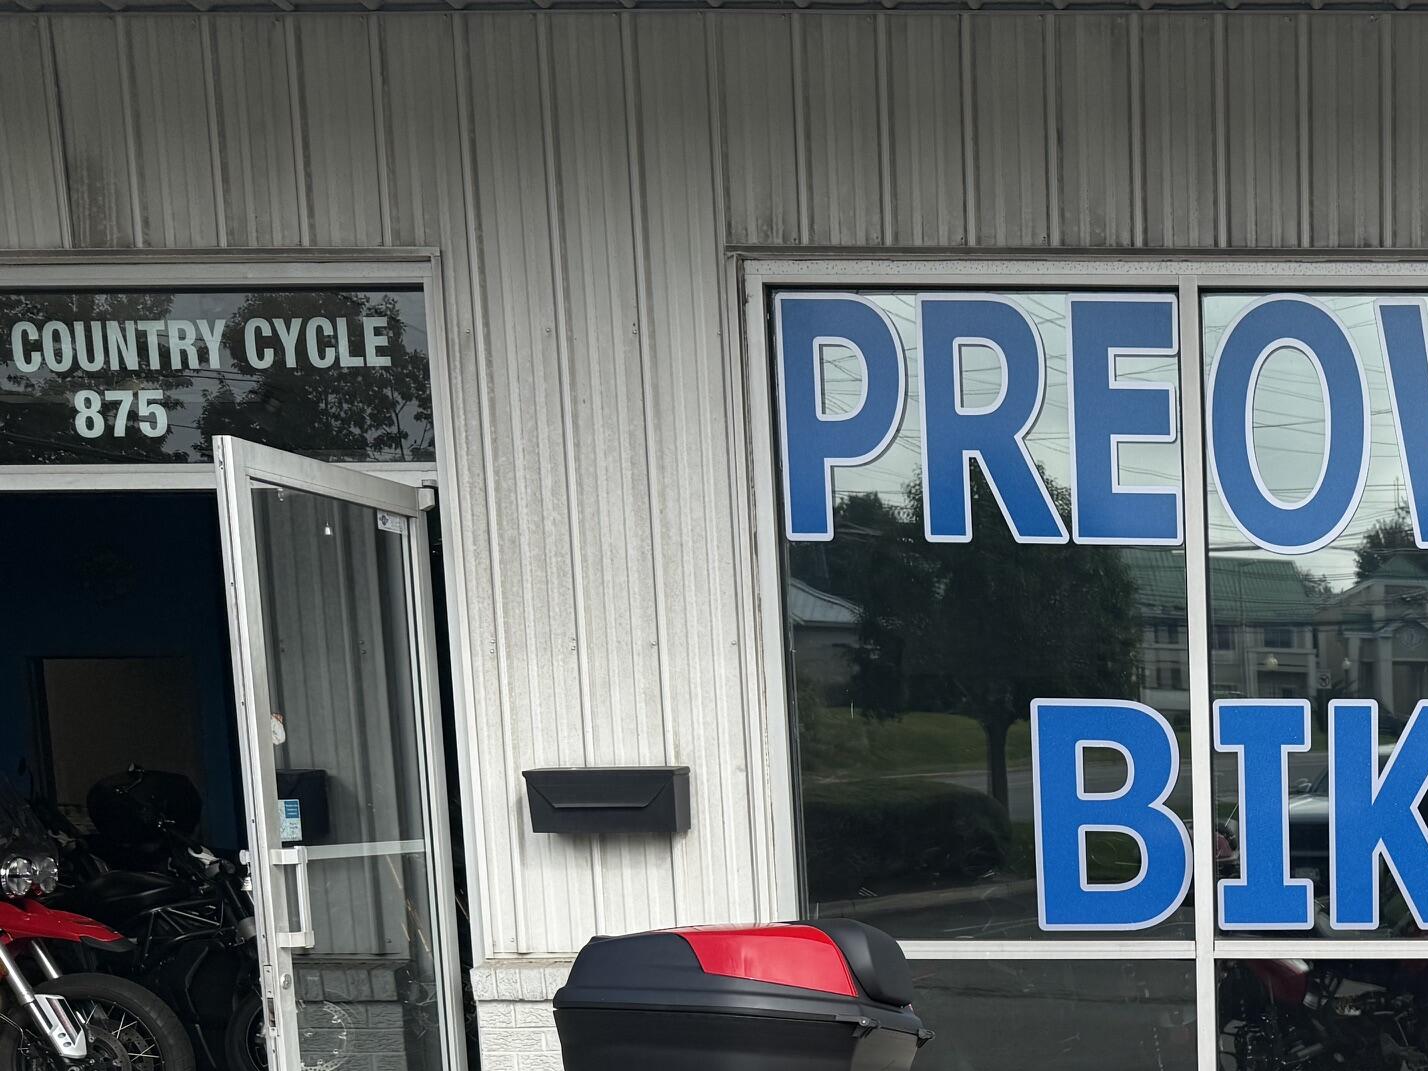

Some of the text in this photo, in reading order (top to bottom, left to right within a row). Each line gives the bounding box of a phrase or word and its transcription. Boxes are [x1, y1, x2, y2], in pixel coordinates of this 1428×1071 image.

[11, 317, 392, 373] COUNTRY CYCLE
[74, 389, 168, 438] 875
